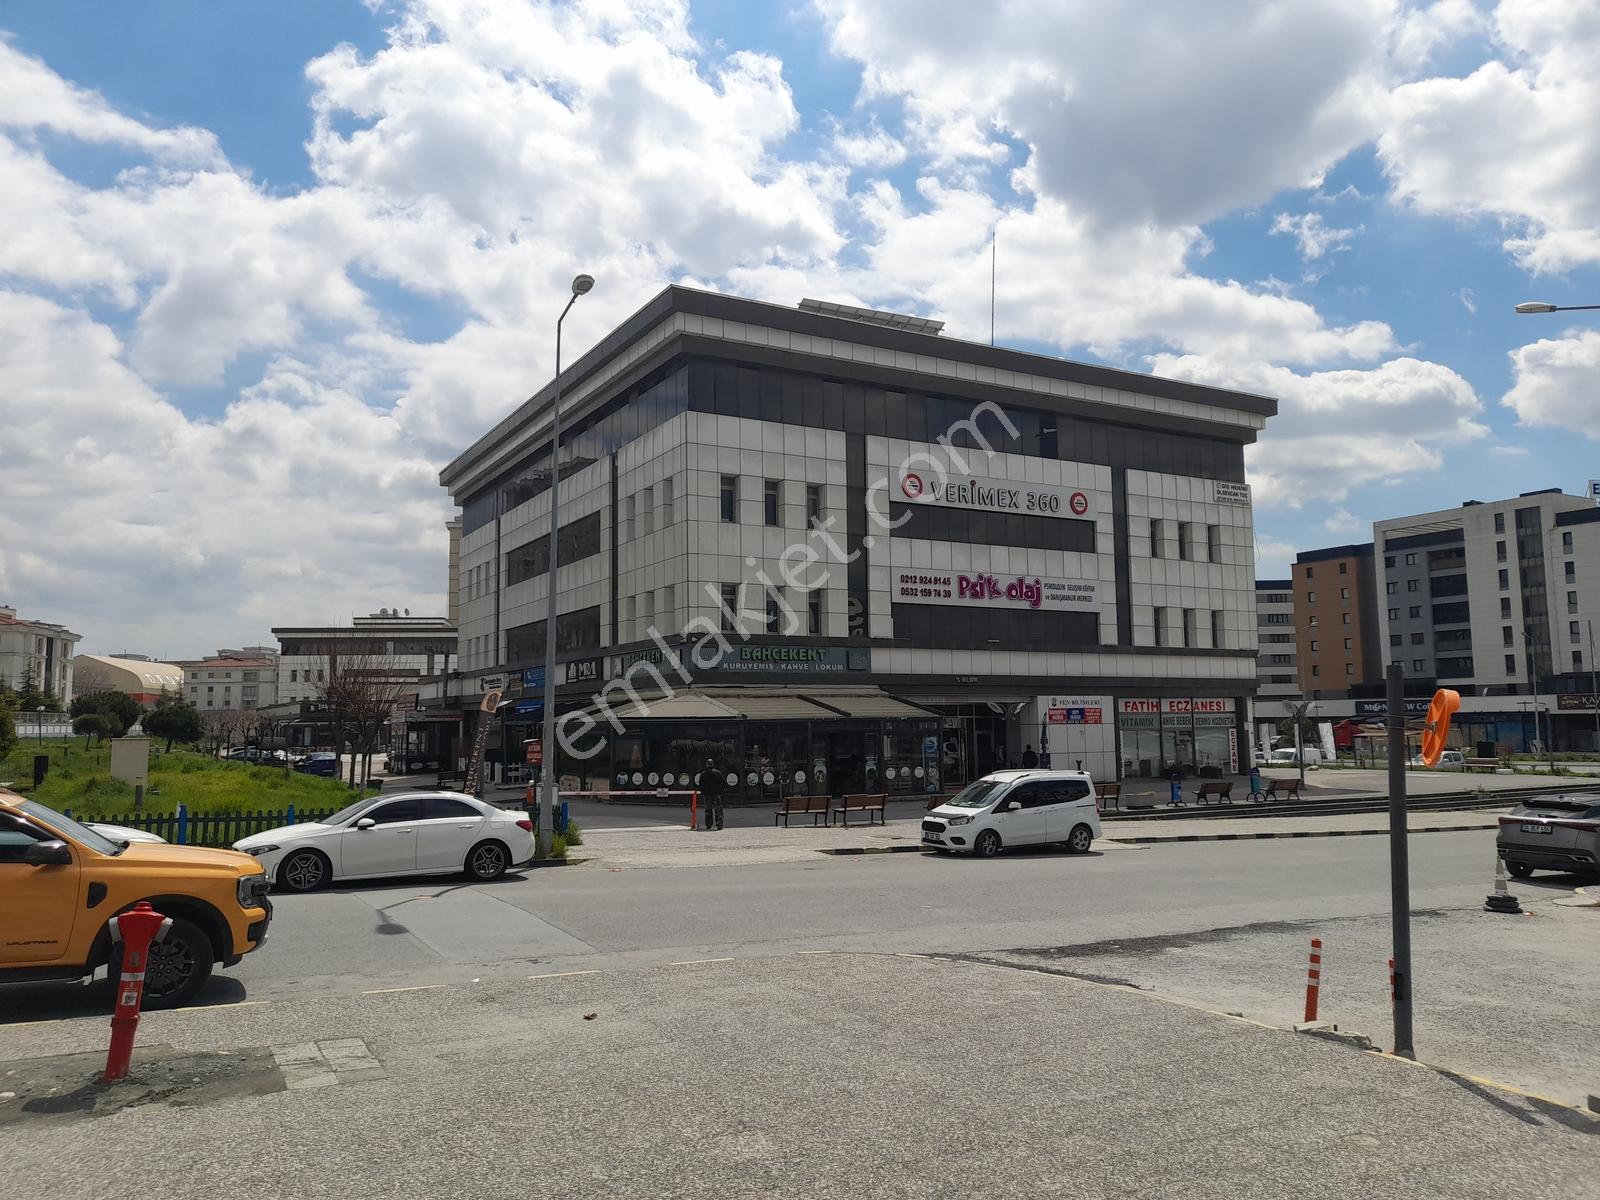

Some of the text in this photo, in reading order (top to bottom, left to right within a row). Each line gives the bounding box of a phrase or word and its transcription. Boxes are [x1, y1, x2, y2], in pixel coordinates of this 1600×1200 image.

[931, 479, 1061, 512] VERİMEX 360
[900, 574, 918, 585] 0212
[919, 575, 933, 586] 924
[900, 587, 952, 599] 0532 159 74 39
[741, 647, 828, 663] BAHÇEKENT
[781, 663, 809, 671] KAHVE
[815, 664, 844, 672] LOKUM
